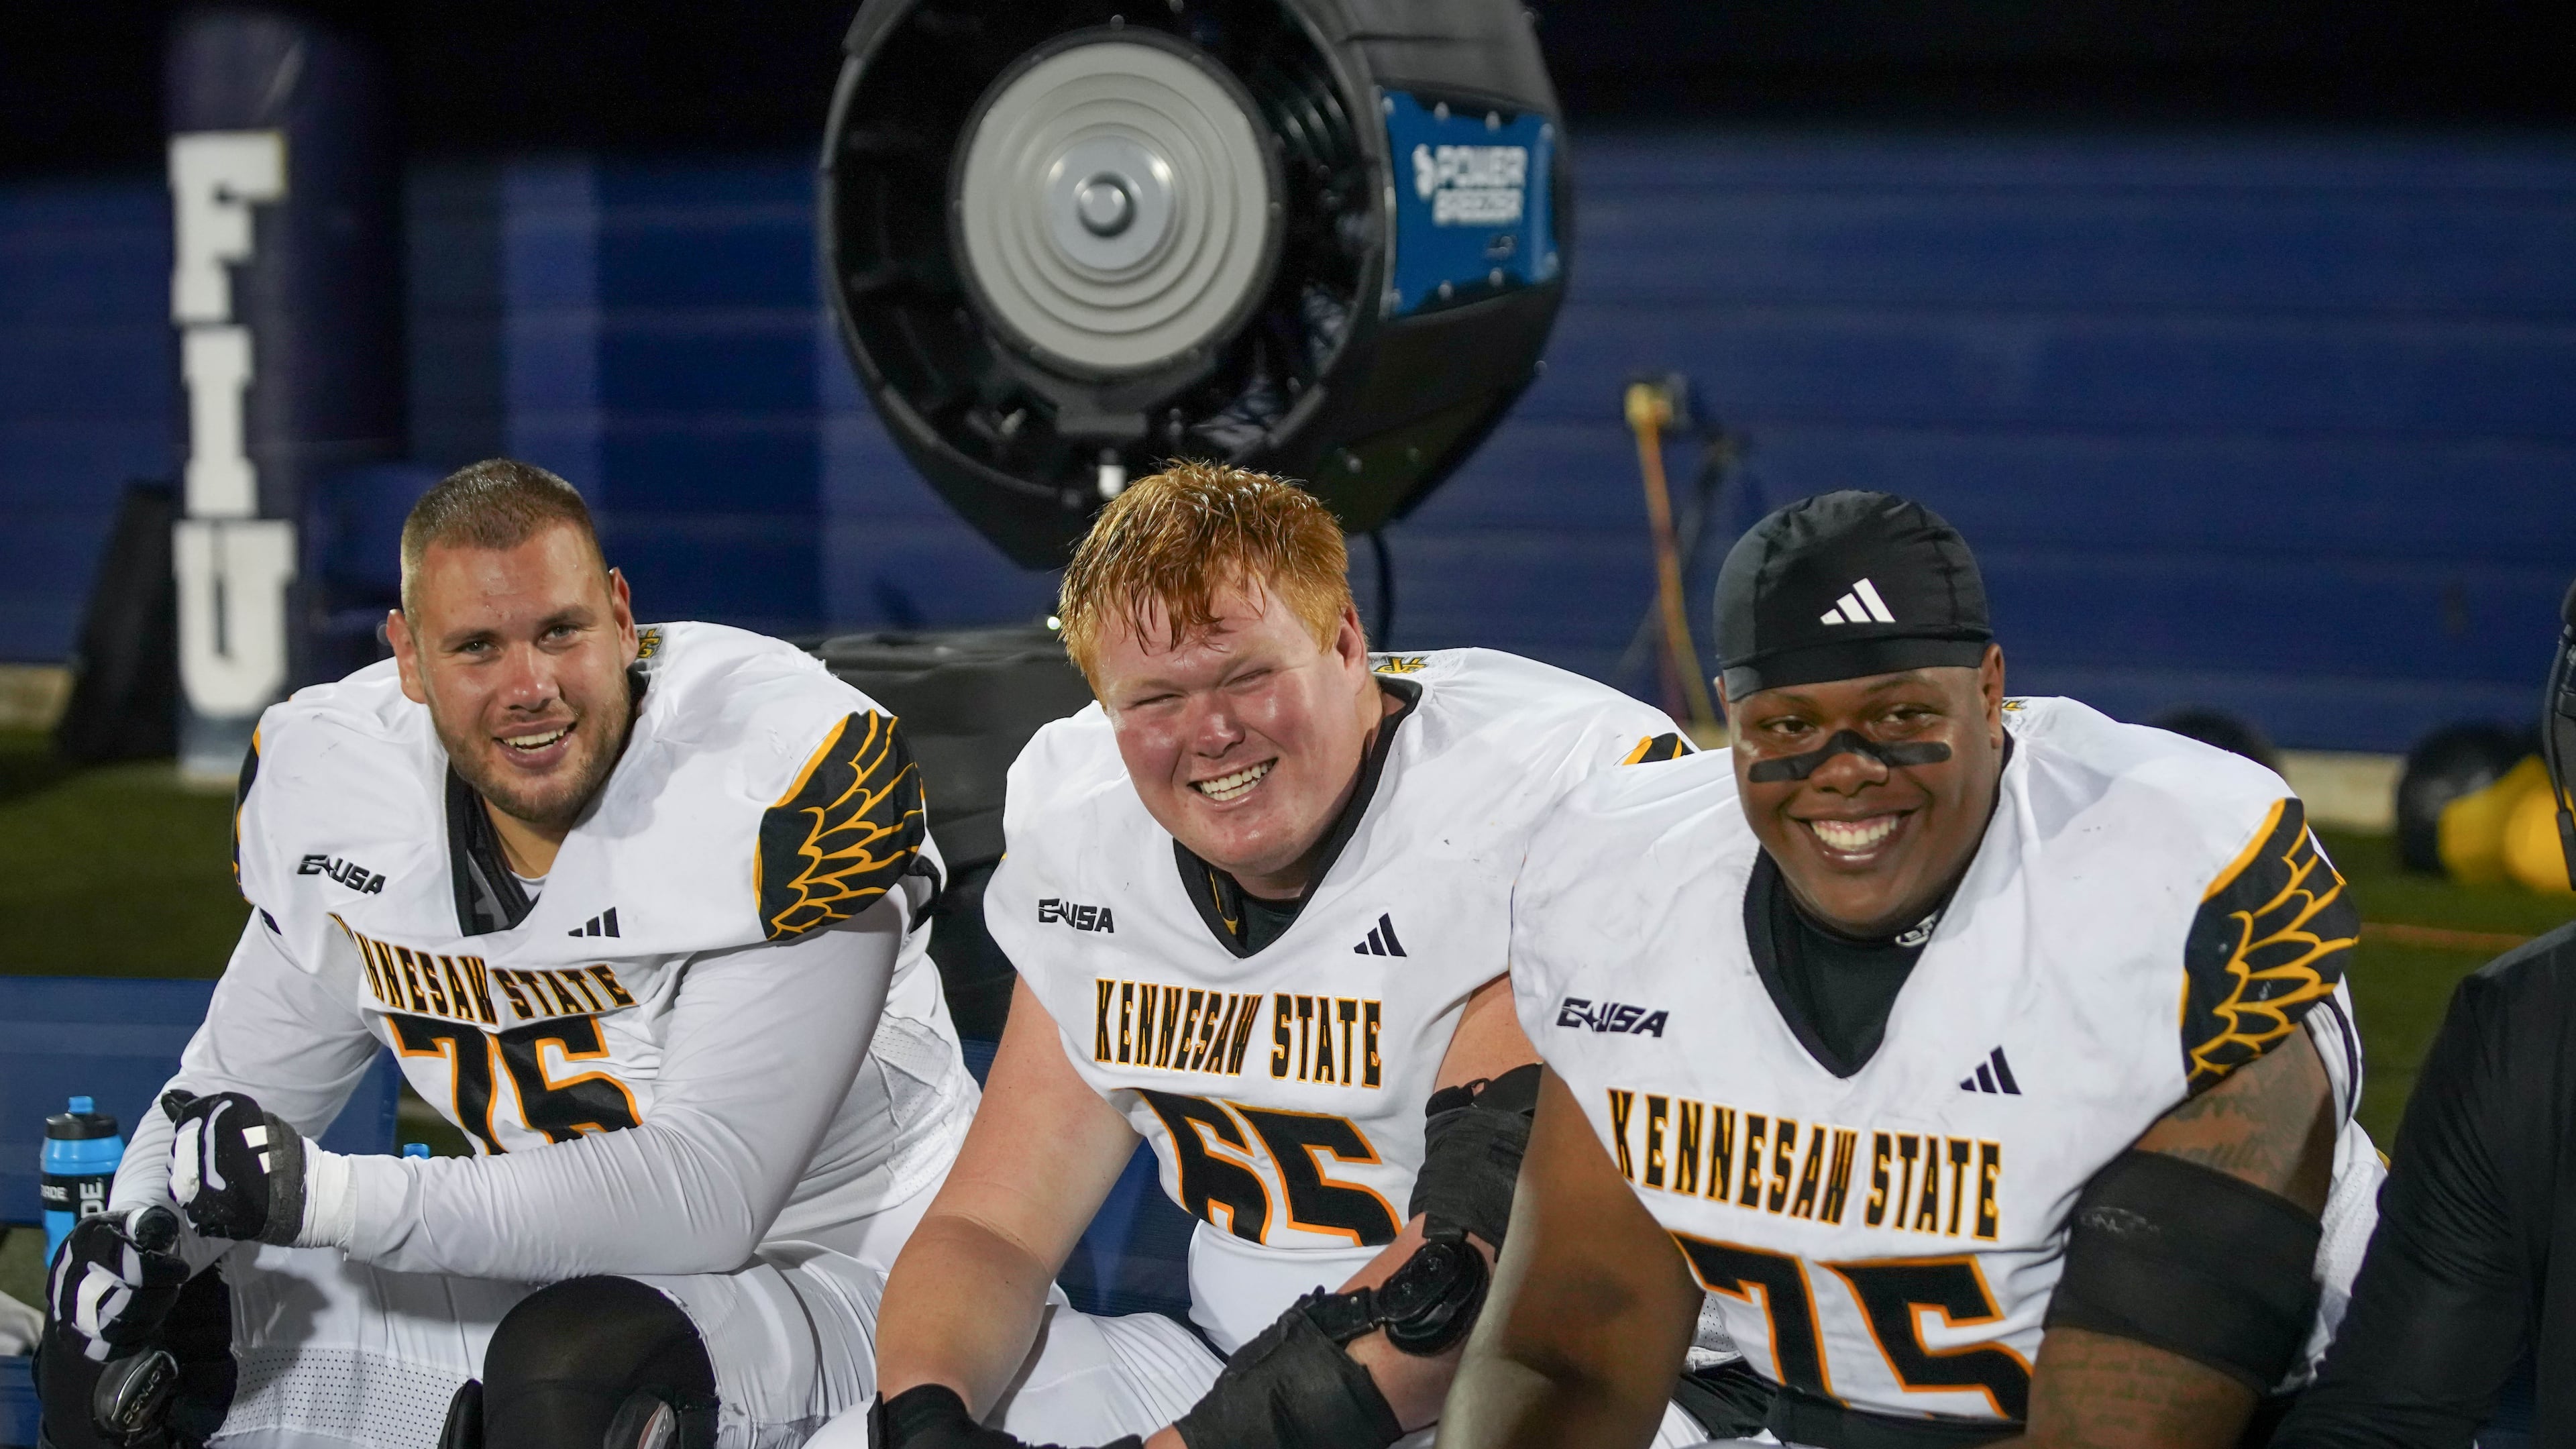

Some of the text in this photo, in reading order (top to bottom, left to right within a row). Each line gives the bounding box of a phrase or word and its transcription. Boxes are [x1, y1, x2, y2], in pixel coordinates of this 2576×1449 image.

[1435, 144, 1528, 187] POWER
[490, 963, 637, 1020] STATE
[1094, 977, 1382, 1089] KENNESAW STATE
[1110, 1087, 1405, 1246] 65
[1607, 1087, 2001, 1241] KENNESAW STATE
[1669, 1228, 2033, 1426] 75
